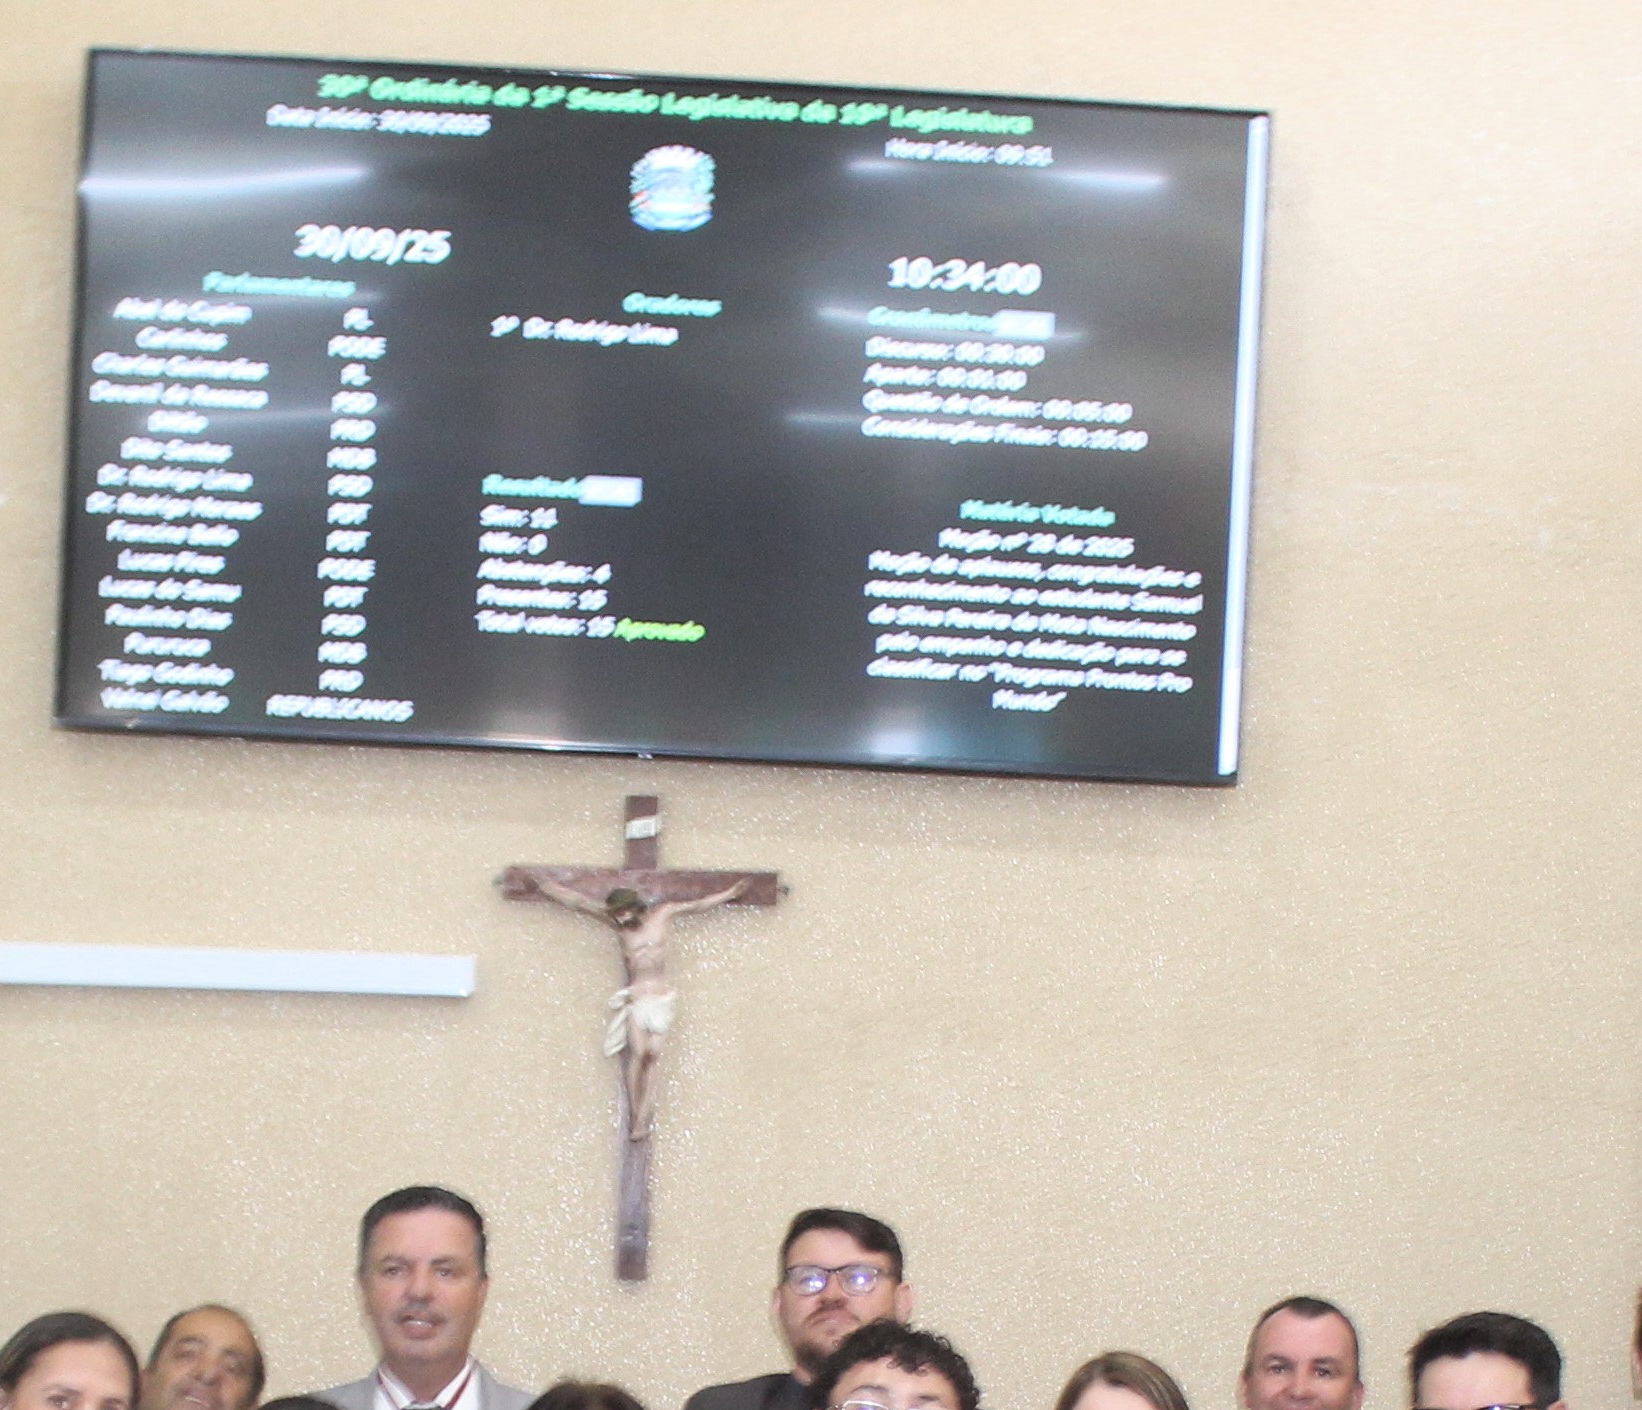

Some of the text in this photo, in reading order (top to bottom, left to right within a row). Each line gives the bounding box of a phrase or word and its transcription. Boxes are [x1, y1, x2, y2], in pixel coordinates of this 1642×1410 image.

[492, 82, 531, 106] da
[565, 85, 660, 113] Sessão
[658, 91, 801, 125] Legislativa
[800, 98, 839, 123] da
[888, 103, 1036, 137] Legislatura
[294, 223, 452, 265] 30/09/25
[887, 255, 1043, 296] 10:34:00
[343, 308, 373, 328] PL
[520, 317, 555, 337] Dr.
[552, 318, 631, 345] Rodrigo
[627, 322, 680, 345] Lima
[340, 364, 370, 384] PL
[941, 393, 972, 414] de
[969, 394, 1046, 417] Ordem:
[97, 463, 253, 492] Dr. Rodrigo Lima
[116, 492, 193, 519] Rodrigo
[1054, 534, 1085, 554] de
[929, 554, 960, 575] de
[1184, 570, 1203, 586] e
[474, 611, 526, 632] Total
[612, 618, 705, 644] Aprovado
[1004, 641, 1024, 657] e
[1115, 646, 1163, 667] para
[265, 695, 414, 721] REPUBLICANOS
